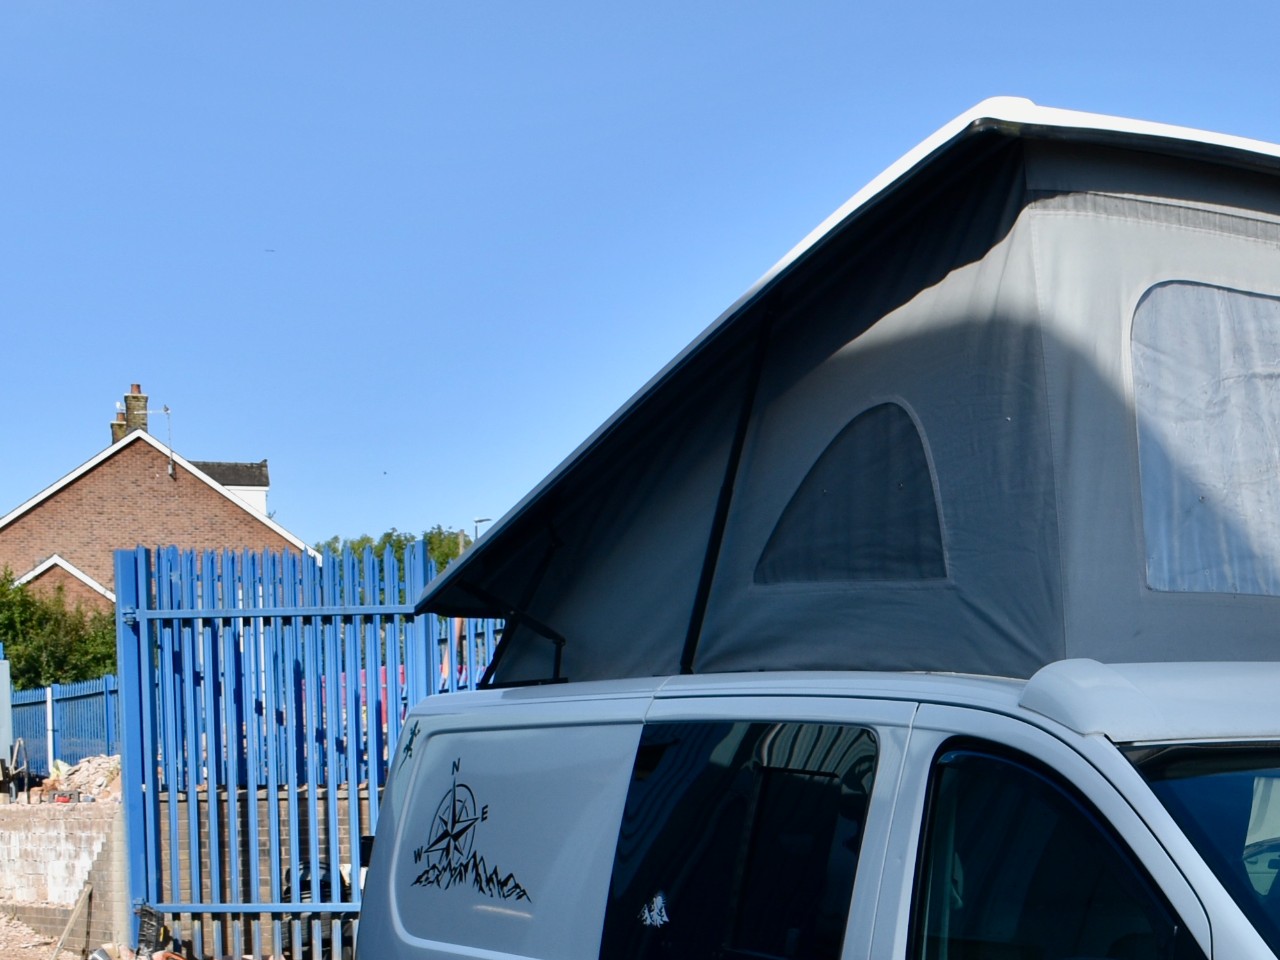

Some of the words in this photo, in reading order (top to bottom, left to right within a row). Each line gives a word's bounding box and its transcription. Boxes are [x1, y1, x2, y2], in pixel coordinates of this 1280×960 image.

[451, 757, 461, 775] N
[480, 804, 489, 822] E
[413, 845, 424, 864] W
